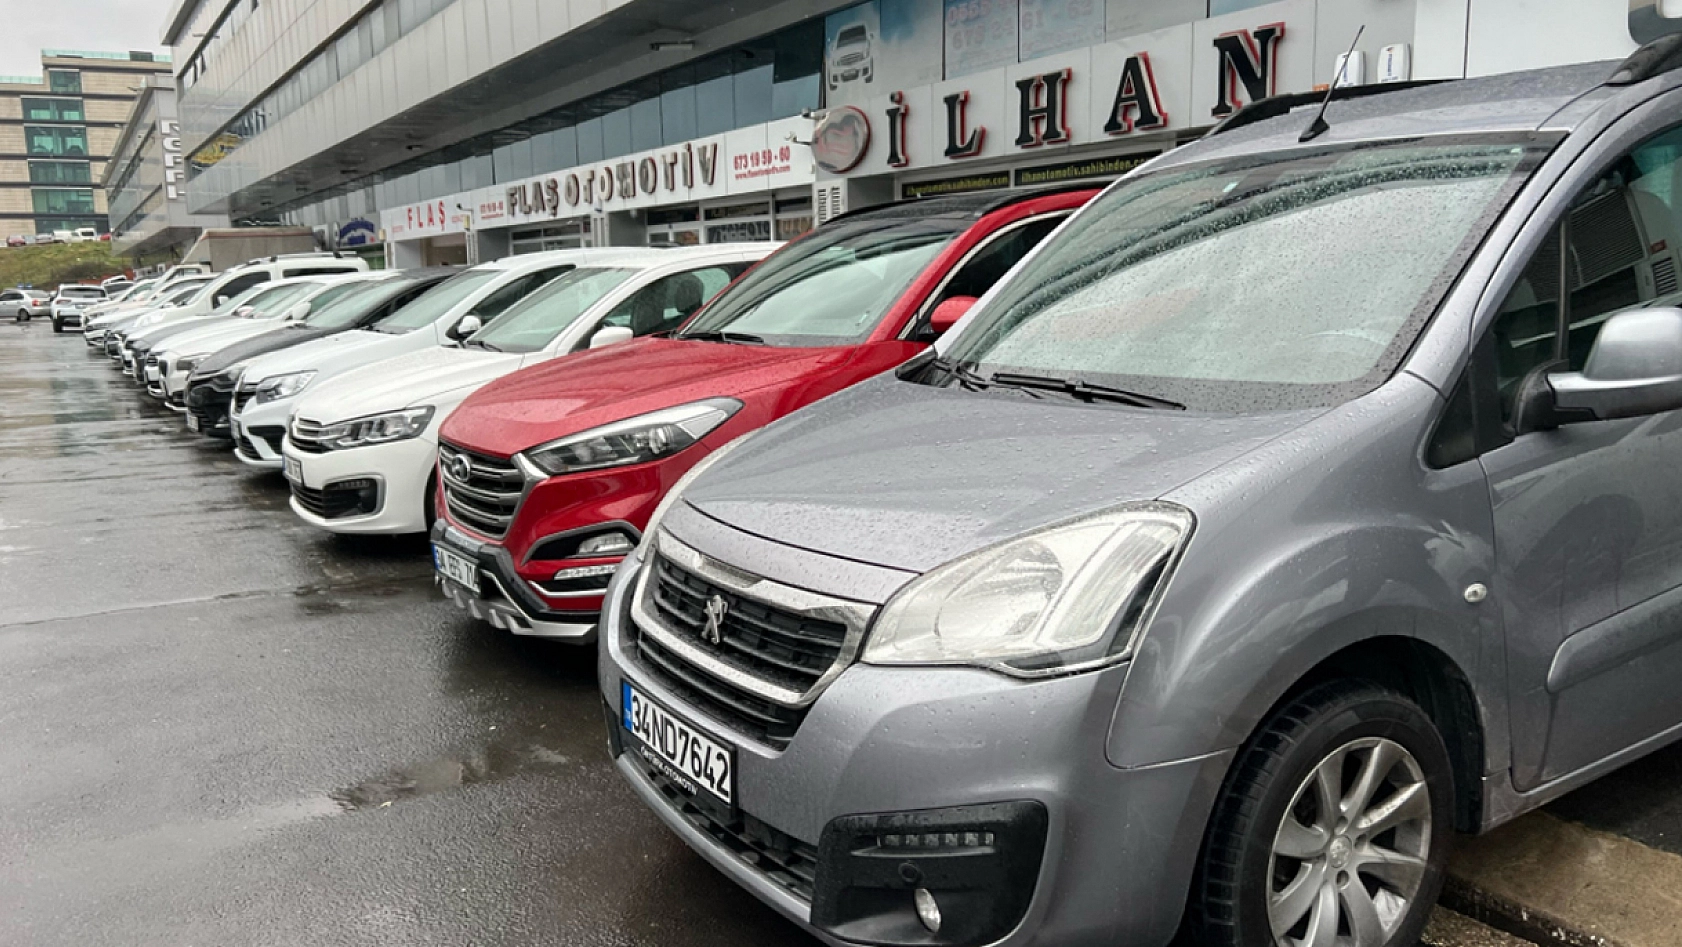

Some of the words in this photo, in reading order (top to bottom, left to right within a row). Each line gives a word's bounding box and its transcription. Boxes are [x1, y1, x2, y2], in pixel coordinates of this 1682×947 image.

[506, 178, 559, 217] FLAŞ
[565, 142, 718, 206] OTOMOTİV
[407, 199, 446, 231] FLAŞ
